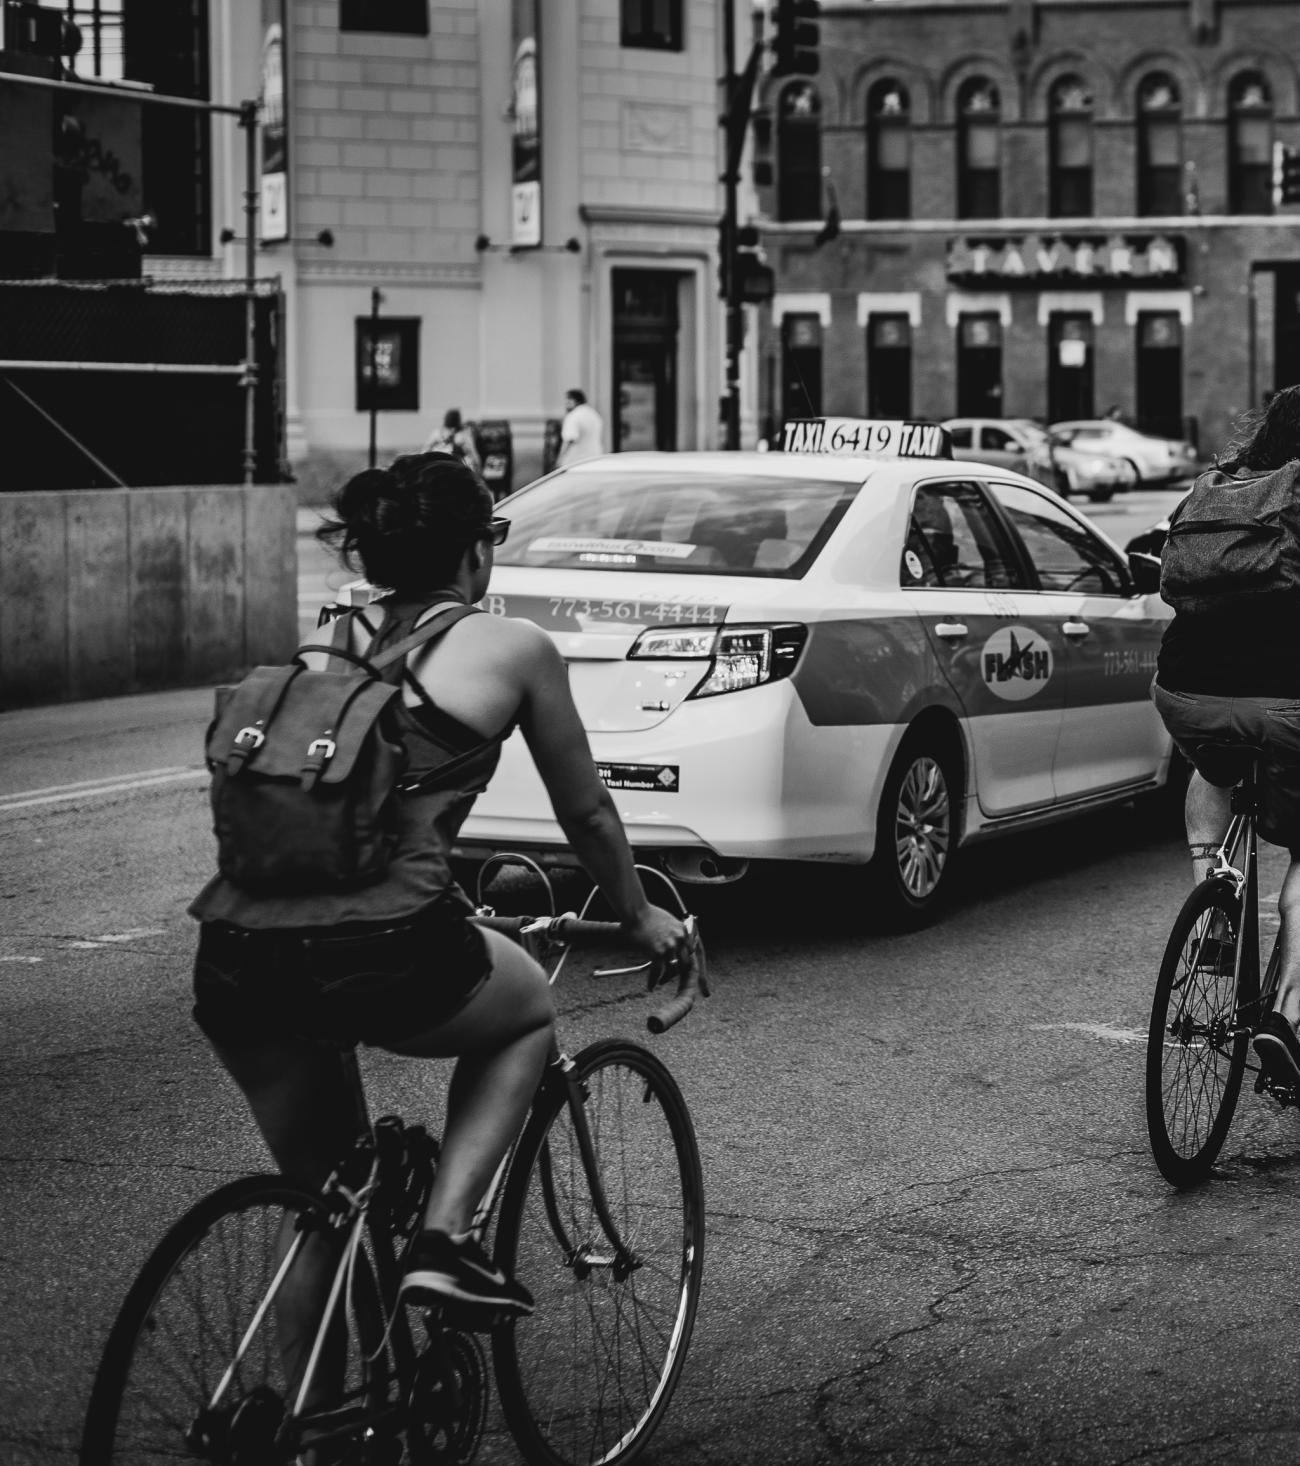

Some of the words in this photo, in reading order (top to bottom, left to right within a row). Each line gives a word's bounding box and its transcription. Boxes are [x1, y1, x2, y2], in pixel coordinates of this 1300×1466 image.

[973, 247, 1179, 275] TAVERN
[784, 422, 823, 453] TAXI
[831, 423, 891, 452] 6419
[900, 425, 942, 457] TAXI
[550, 599, 718, 624] 773-561-4444
[984, 640, 1049, 683] FLASH
